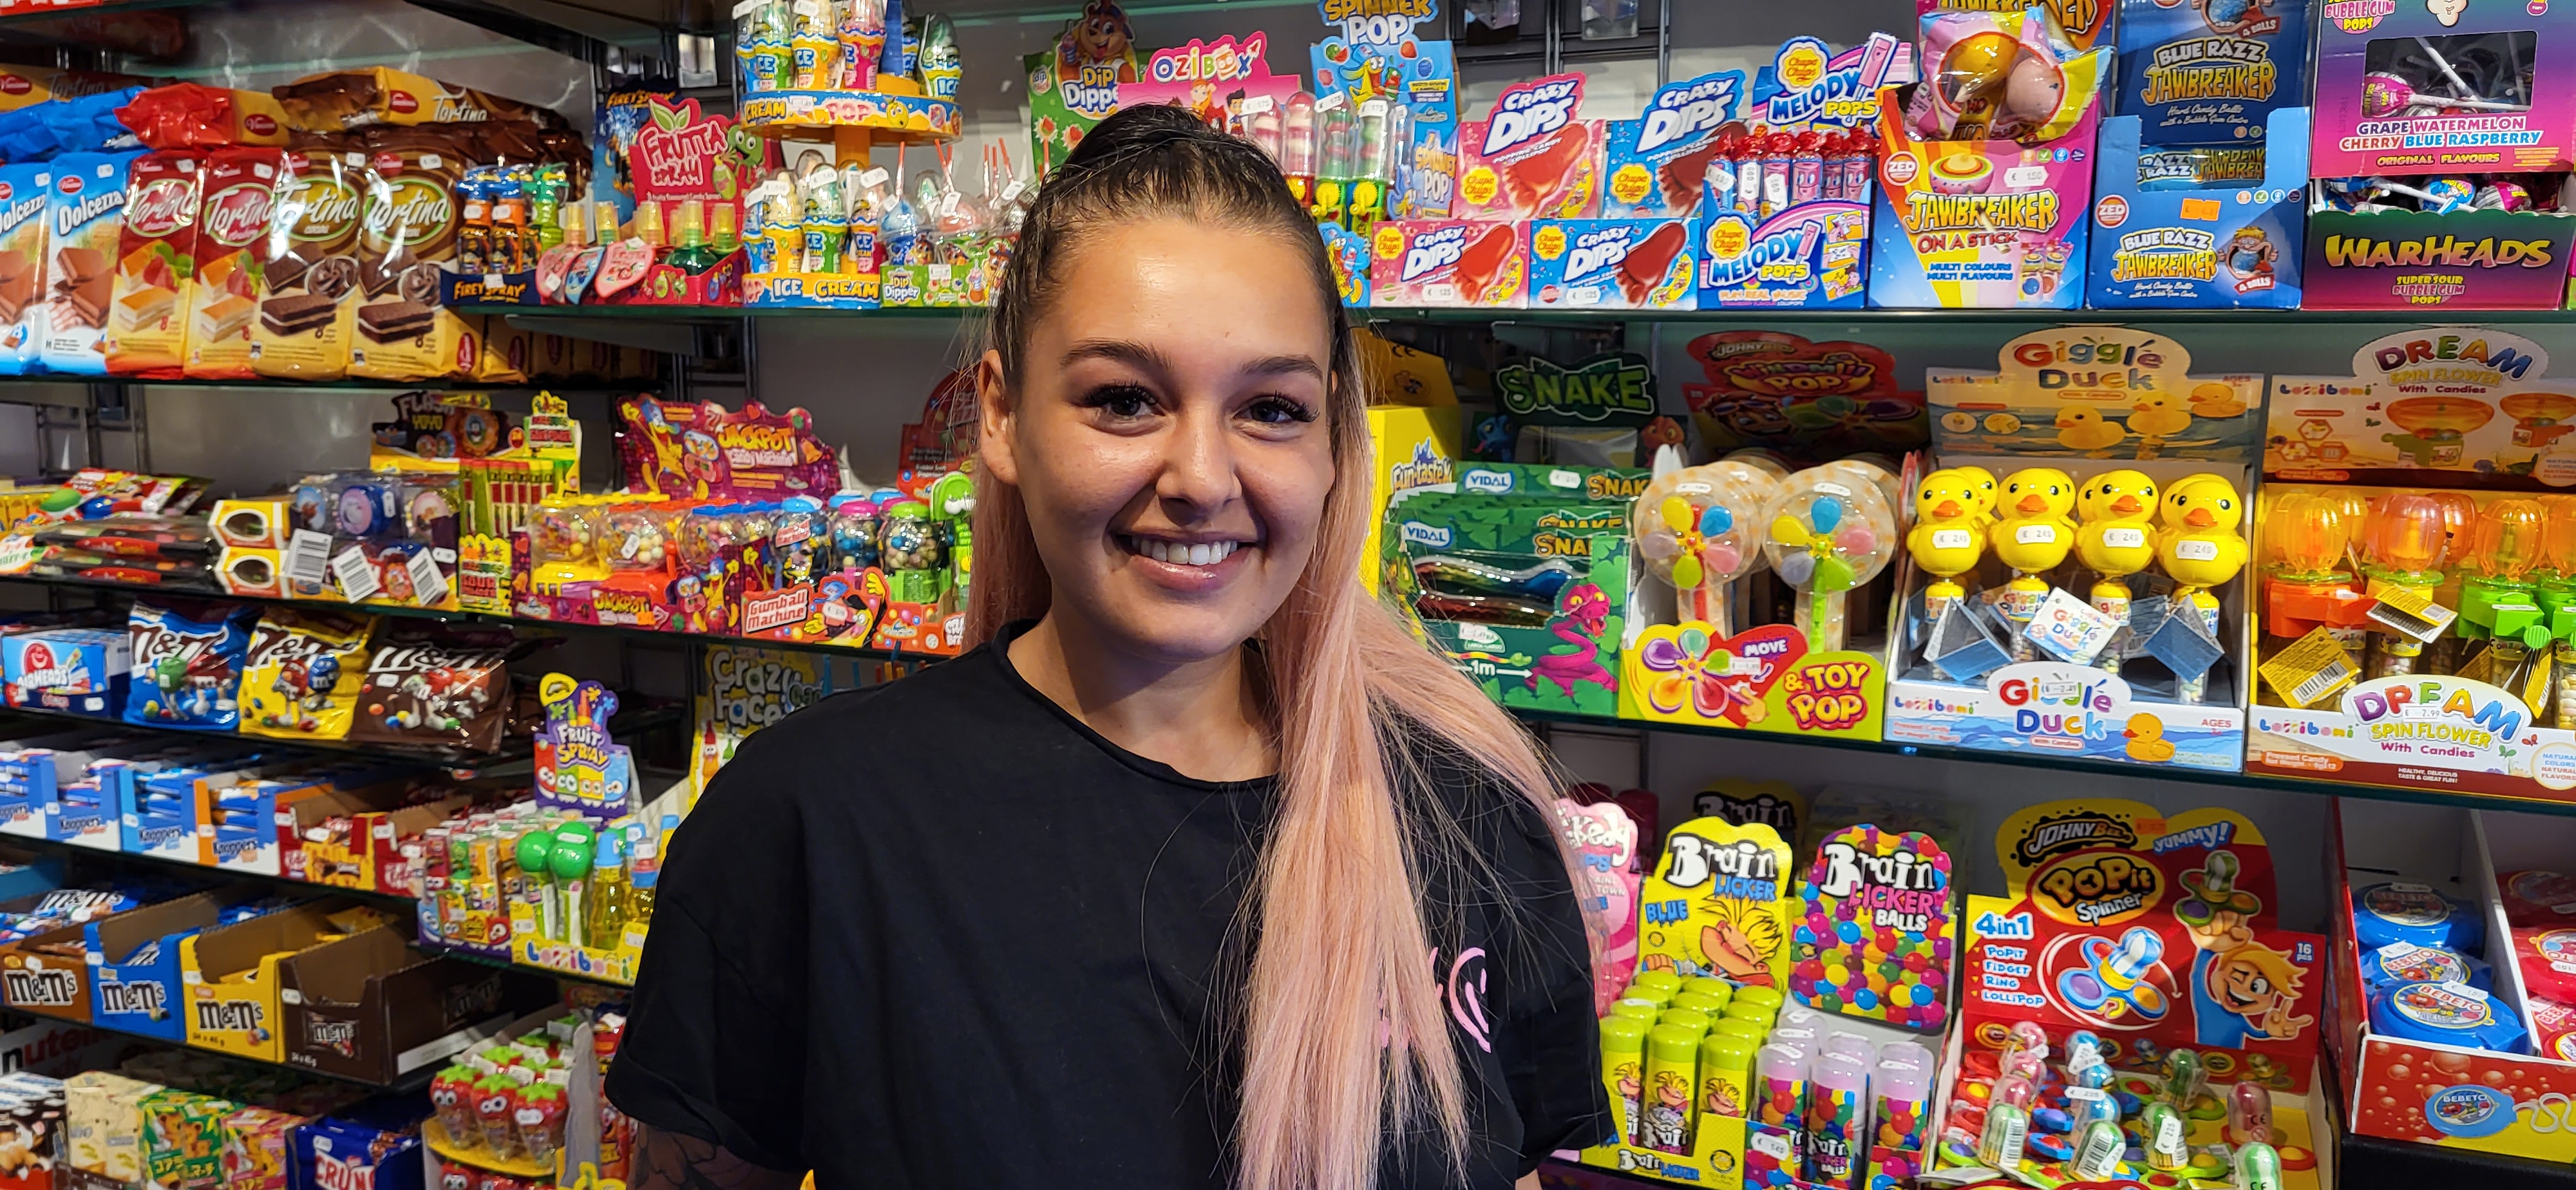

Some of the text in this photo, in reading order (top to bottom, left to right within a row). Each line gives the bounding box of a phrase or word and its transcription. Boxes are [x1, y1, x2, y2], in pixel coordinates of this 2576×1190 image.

[2325, 1, 2395, 17] BUBBLE GUM
[1347, 14, 1408, 45] POP
[2344, 17, 2373, 30] POPS
[2159, 39, 2266, 68] BLUE RAZZ
[1658, 78, 1736, 108] CRAZY
[2143, 61, 2274, 104] JAWBREAKER
[1504, 80, 1578, 111] CRAZY
[1773, 70, 1862, 120] MELODY
[1826, 101, 1875, 116] POPS
[1483, 97, 1574, 156] DIPS
[1636, 94, 1734, 153] DIPS
[2359, 118, 2525, 135] GRAPE WATERMELON
[2342, 131, 2541, 149] CHERRY BLUE RASPBERRY
[1888, 161, 1916, 171] ZED
[2377, 154, 2500, 166] ORIGINAL FLAVOURS
[1425, 169, 1449, 203] POP
[58, 191, 125, 236] Dolcezza
[1906, 190, 2057, 231] JAWBREAKER
[2099, 205, 2126, 215] ZED
[1414, 227, 1466, 248] CRAZY
[1578, 226, 1632, 248] CRAZY
[1918, 232, 2018, 253] ON A STICK
[2125, 231, 2211, 251] BLUE RAZZ
[1401, 239, 1464, 281] DIPS
[1564, 238, 1629, 282] DIPS
[1712, 232, 1803, 283] MELODY
[2325, 234, 2552, 268] WARHEADS
[1761, 265, 1806, 279] POPS
[1929, 262, 2012, 271] MULTI COLOURS
[2113, 251, 2217, 281] JAWBREAKER
[773, 279, 803, 296] ICE
[816, 281, 880, 299] CREAM
[2392, 285, 2465, 295] BUBBLE GUM
[2396, 276, 2464, 285] SUPER SOUR
[884, 286, 919, 301] Dipper
[2374, 335, 2533, 379] DREAM
[1499, 362, 1653, 413] SNAKE
[1764, 376, 1842, 391] POP
[2039, 368, 2153, 390] Duck
[2390, 368, 2503, 385] SPIN FLOWER
[2398, 385, 2428, 393] With
[718, 425, 792, 451] JACKPOT
[1471, 475, 1508, 486] VIDAL
[1586, 473, 1649, 499] SNAK
[1407, 527, 1446, 542] VIDAL
[750, 591, 806, 615] Gumball
[748, 608, 804, 628] Machine
[1744, 639, 1787, 656] MOVE
[2052, 622, 2089, 650] Duck
[1471, 660, 1497, 677] 1m
[1784, 664, 1869, 692] & TOY
[714, 684, 784, 728] Face
[1790, 695, 1862, 723] POP
[2016, 710, 2105, 739] Duck
[2201, 718, 2231, 728] AGES
[2371, 723, 2492, 748] SPIN FLOWER
[558, 743, 608, 766] SPRAY
[2381, 742, 2476, 759] With Candies
[1668, 835, 1777, 887] Brain
[1820, 844, 1935, 896] Brain
[1714, 874, 1777, 901] LICKER
[1848, 881, 1934, 917] LICKER
[1645, 900, 1689, 927] BLUE
[1875, 909, 1928, 932] BALLS
[2076, 894, 2141, 924] Spinner
[1976, 914, 2031, 936] 4in1
[2297, 943, 2312, 954] 16
[2385, 949, 2434, 971] BEBETO
[2420, 985, 2484, 1012] BEBETO
